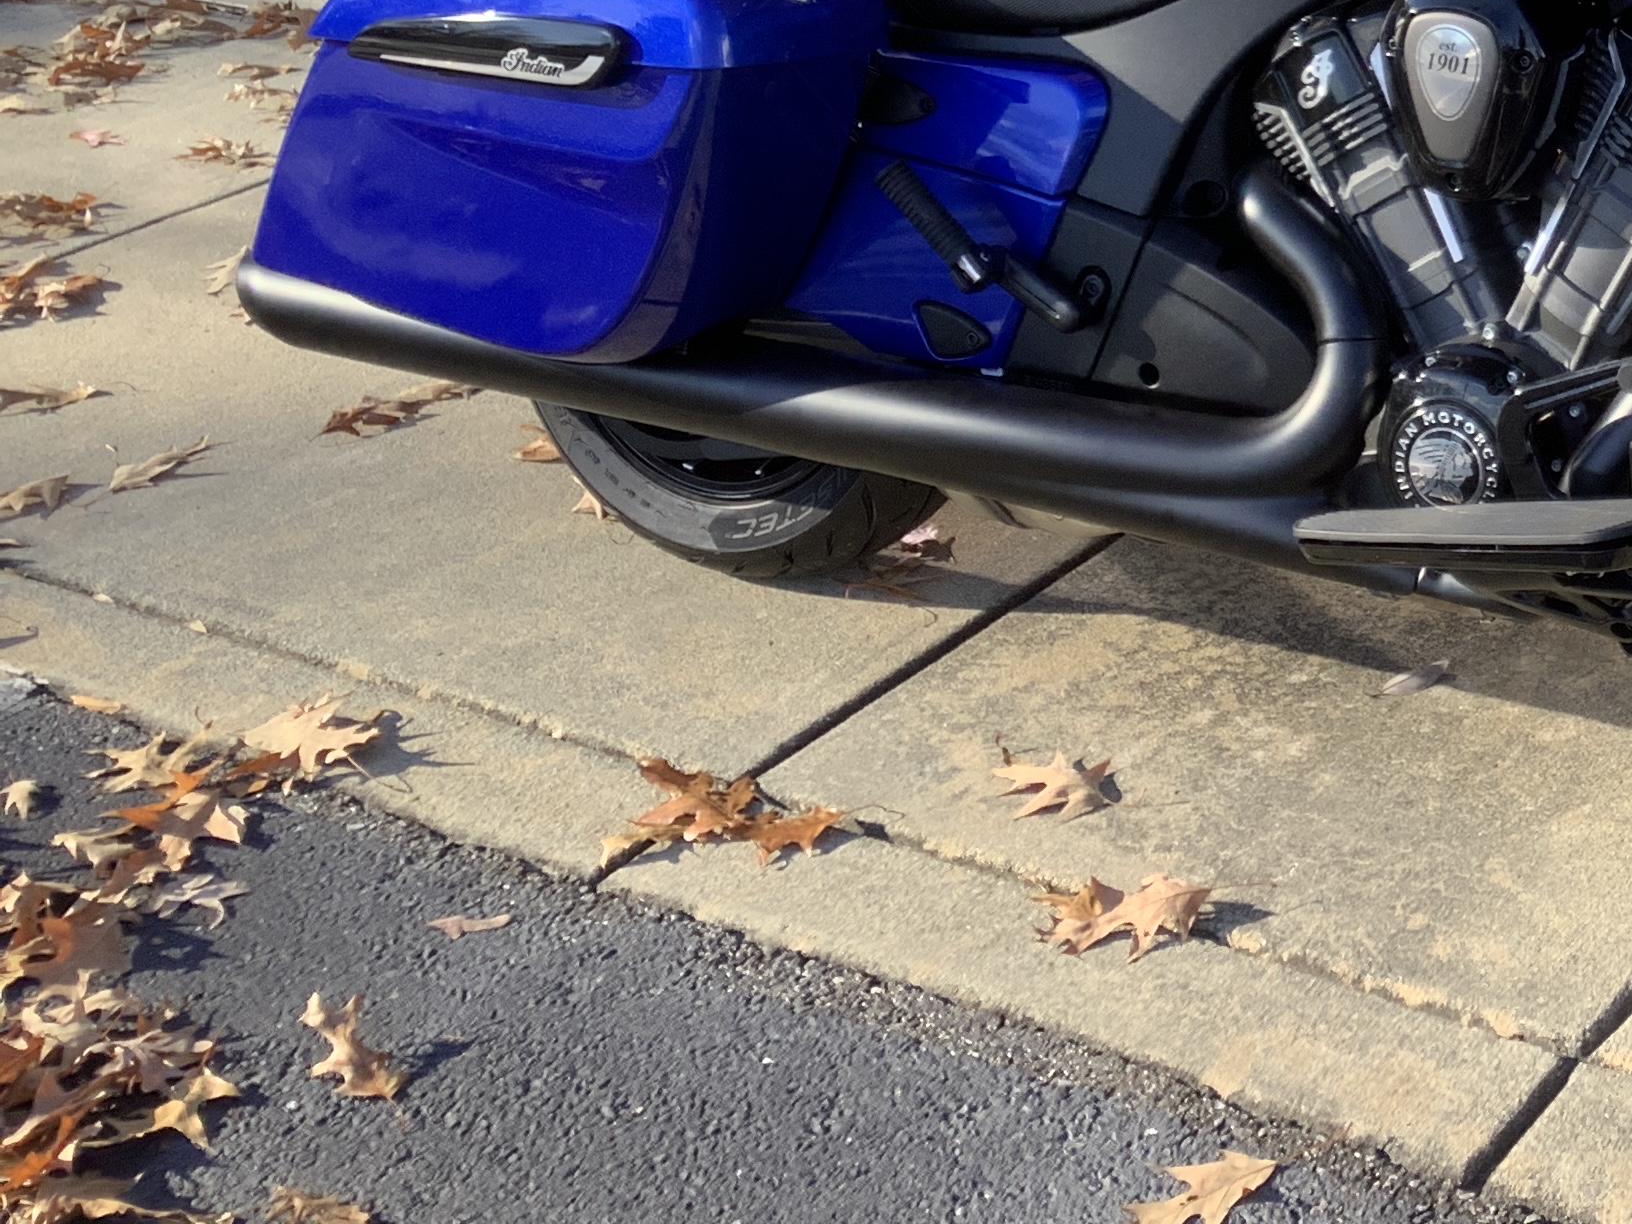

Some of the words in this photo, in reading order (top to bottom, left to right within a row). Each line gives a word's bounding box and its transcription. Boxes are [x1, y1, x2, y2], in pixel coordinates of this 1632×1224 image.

[502, 49, 564, 78] Indian
[1427, 53, 1469, 74] 1901
[1394, 422, 1419, 500] INDIAN
[1422, 411, 1499, 504] MOTORCYCL
